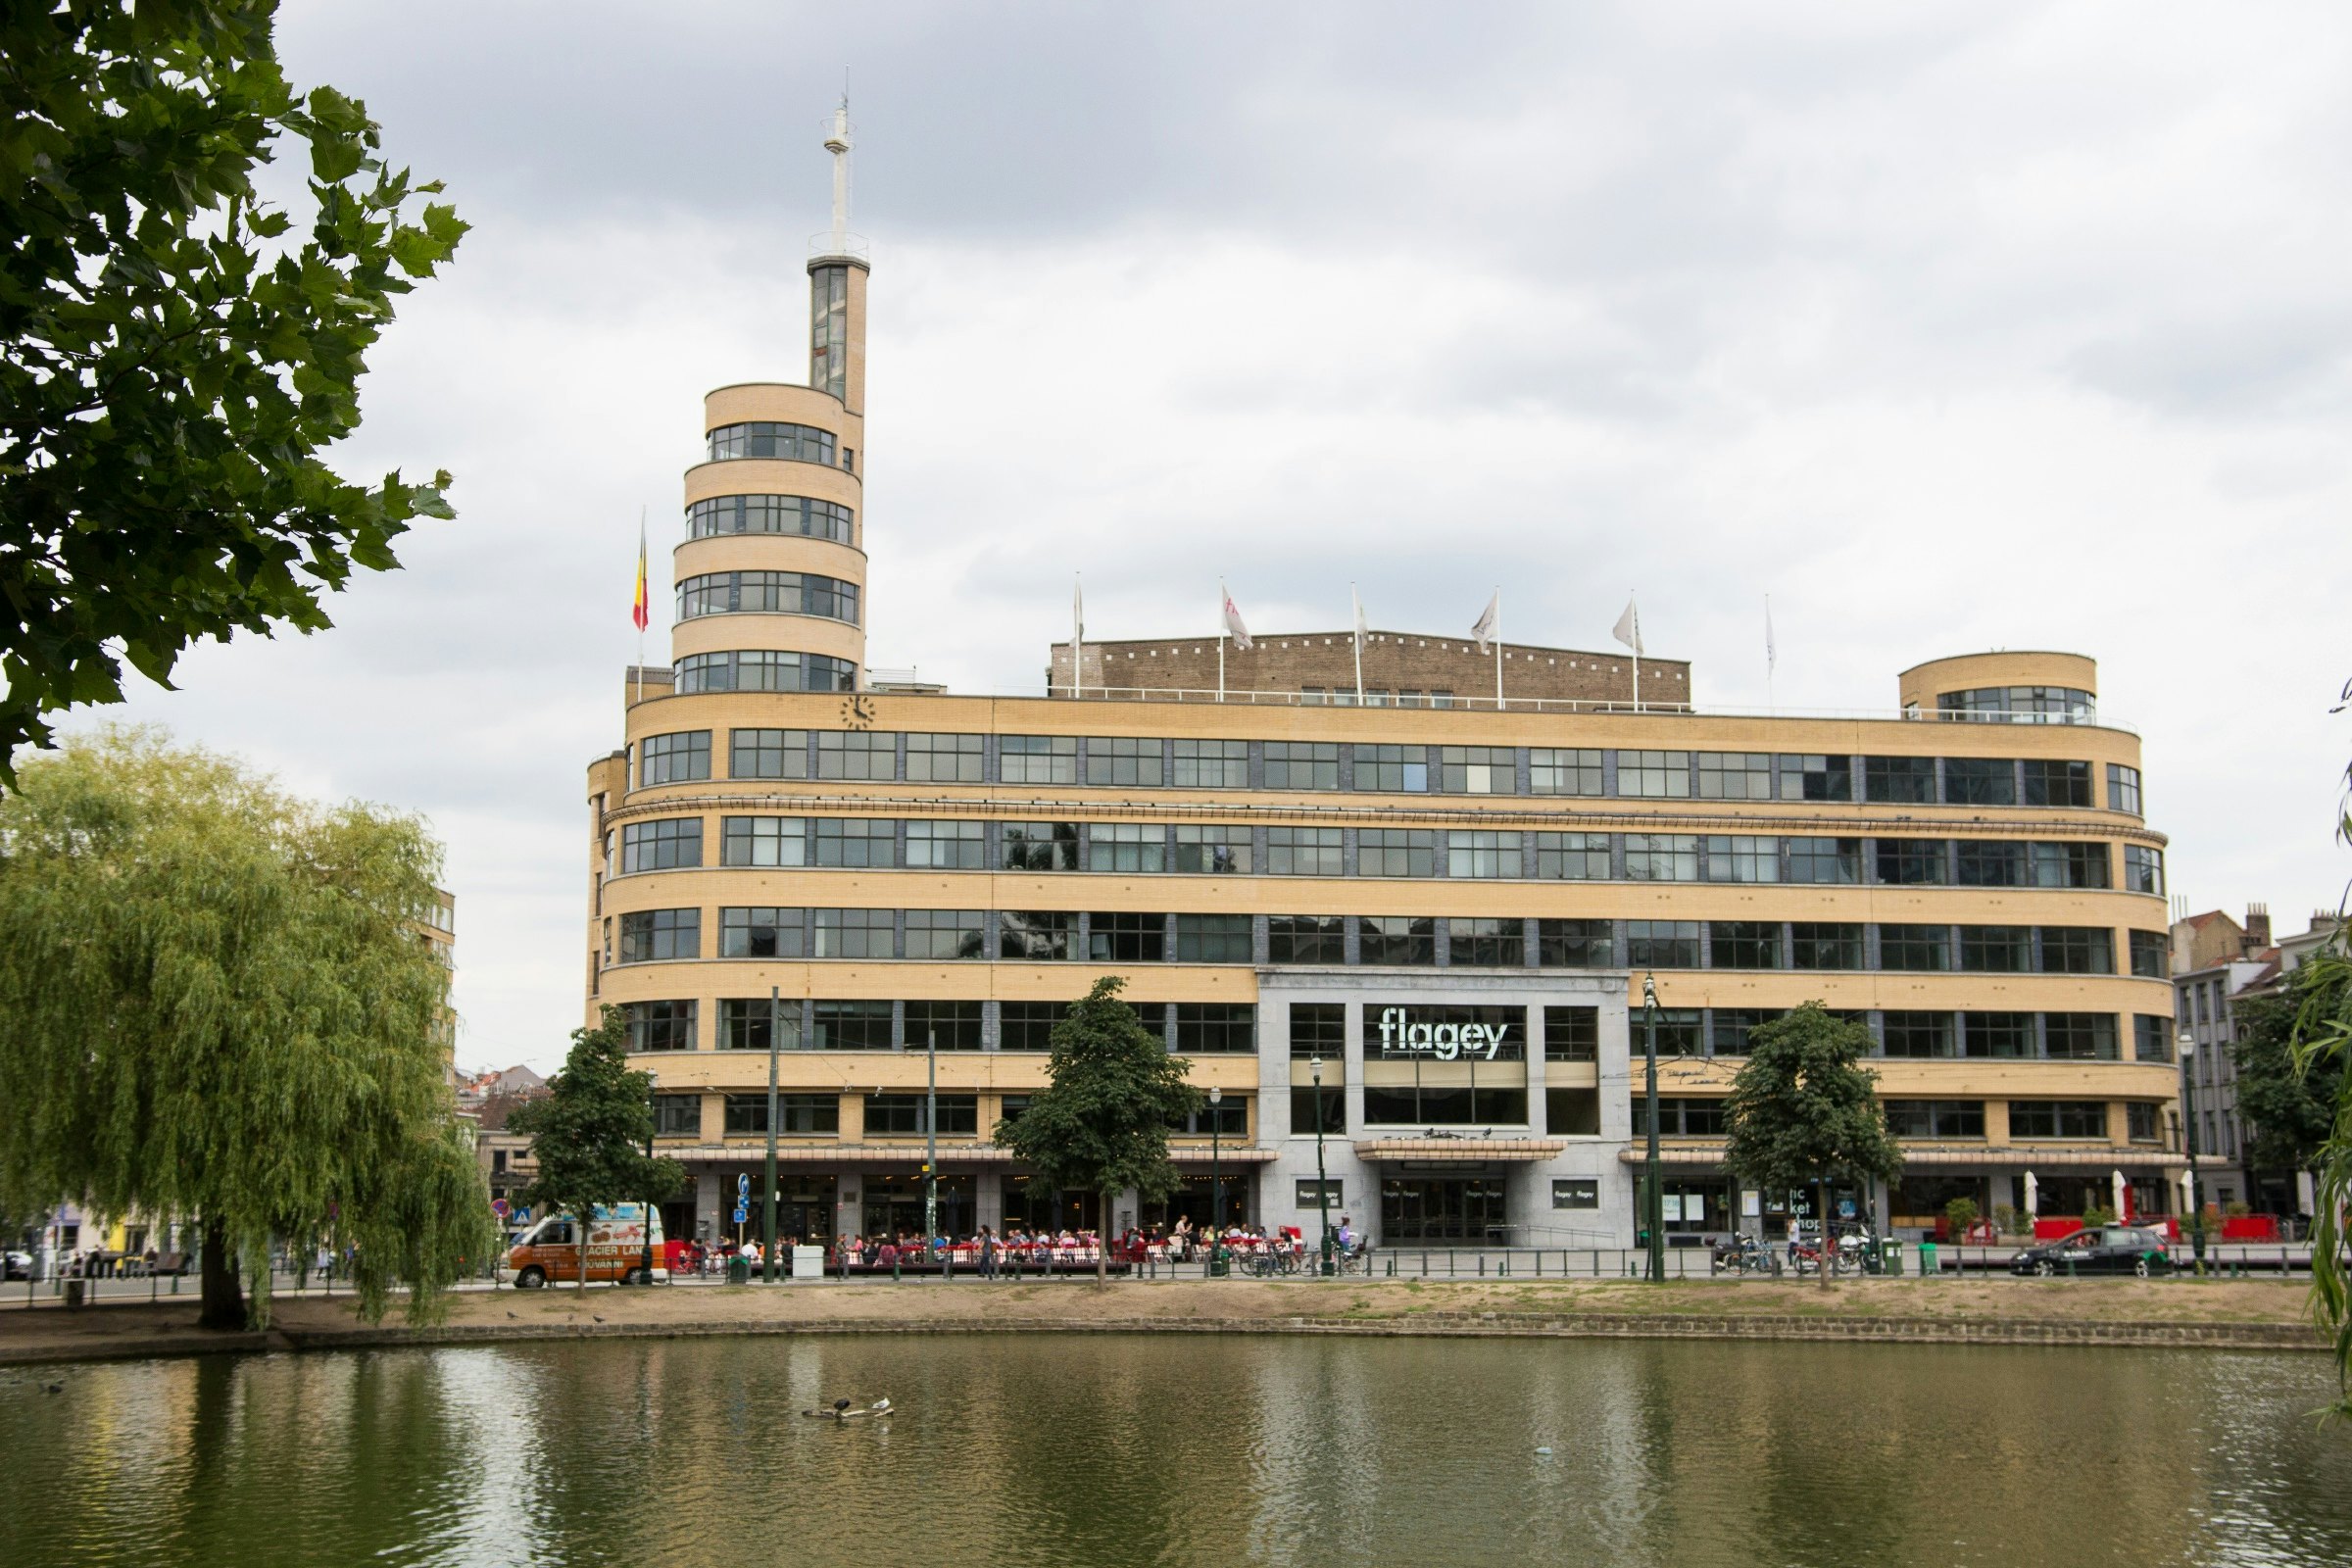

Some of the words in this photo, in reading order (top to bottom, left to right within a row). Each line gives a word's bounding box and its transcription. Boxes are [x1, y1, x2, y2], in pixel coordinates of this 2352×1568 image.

[1379, 1007, 1508, 1060] flagey
[1789, 1200, 1811, 1214] ket
[574, 1246, 617, 1255] GACIER
[577, 1259, 623, 1268] OVANNI
